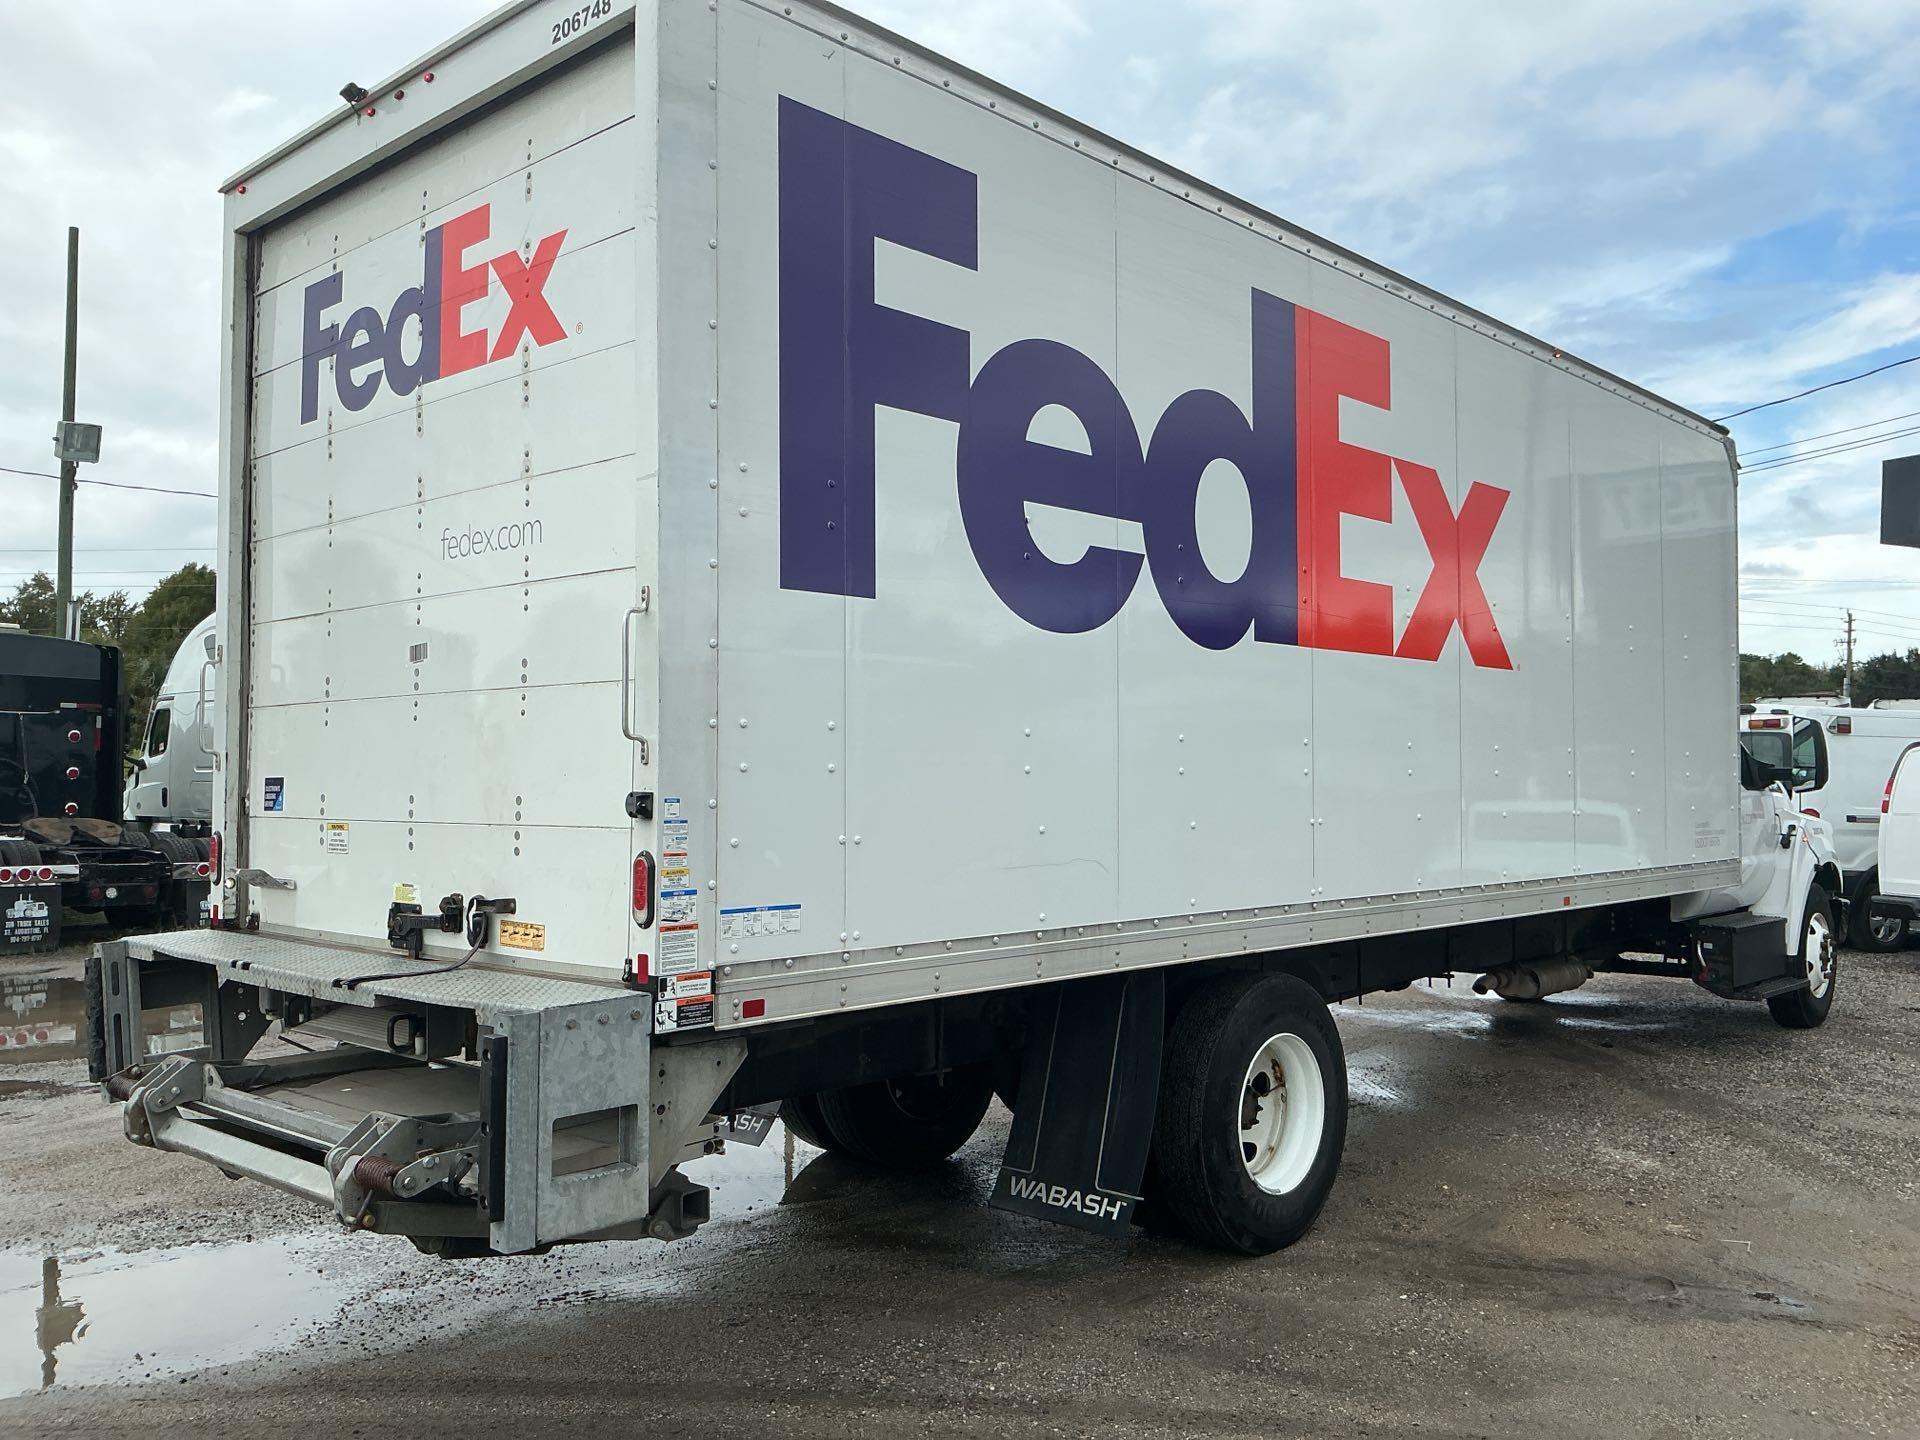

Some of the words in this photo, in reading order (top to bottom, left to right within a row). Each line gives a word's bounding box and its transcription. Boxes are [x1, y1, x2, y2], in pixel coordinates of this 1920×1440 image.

[552, 0, 611, 45] 206748
[301, 203, 569, 426] FedEx
[780, 95, 1513, 671] FedEx
[441, 515, 542, 561] fedex.com
